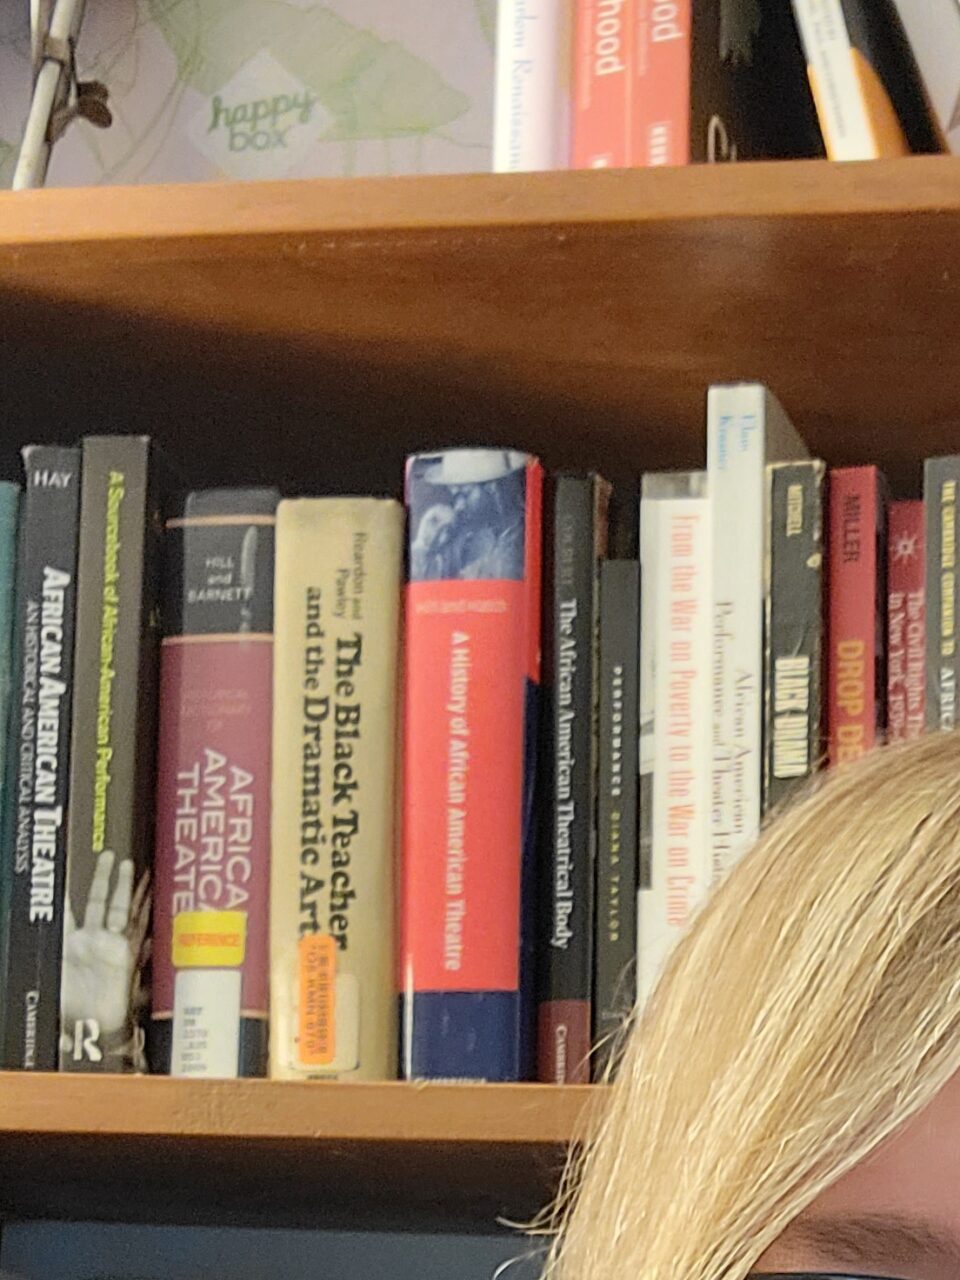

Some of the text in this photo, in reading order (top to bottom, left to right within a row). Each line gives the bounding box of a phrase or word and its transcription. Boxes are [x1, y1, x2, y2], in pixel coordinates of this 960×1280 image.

[208, 92, 319, 135] happy
[229, 126, 289, 152] box
[31, 469, 73, 490] HAY
[104, 487, 125, 583] Sourcebook
[842, 494, 862, 564] MILLER
[102, 586, 120, 602] of
[305, 586, 326, 641] and
[559, 598, 578, 636] The
[888, 612, 906, 645] New
[940, 639, 956, 657] TO
[304, 645, 326, 693] the
[558, 637, 578, 706] African
[774, 655, 810, 712] BLACK
[836, 640, 866, 717] DROP
[21, 711, 36, 738] AND
[29, 565, 71, 922] AFRICAN AMERICAN THEATRE
[666, 514, 701, 928] From the War on Poverty to the War on Crime
[734, 668, 754, 834] African American
[18, 742, 34, 800] CRITICAL
[300, 695, 331, 866] Dramatic
[556, 709, 577, 800] American
[328, 632, 364, 952] The Black Teacher
[443, 631, 471, 972] A History of African American Theatre
[198, 748, 227, 912] AMERIC
[554, 800, 575, 898] Theatrical
[549, 900, 574, 951] Body
